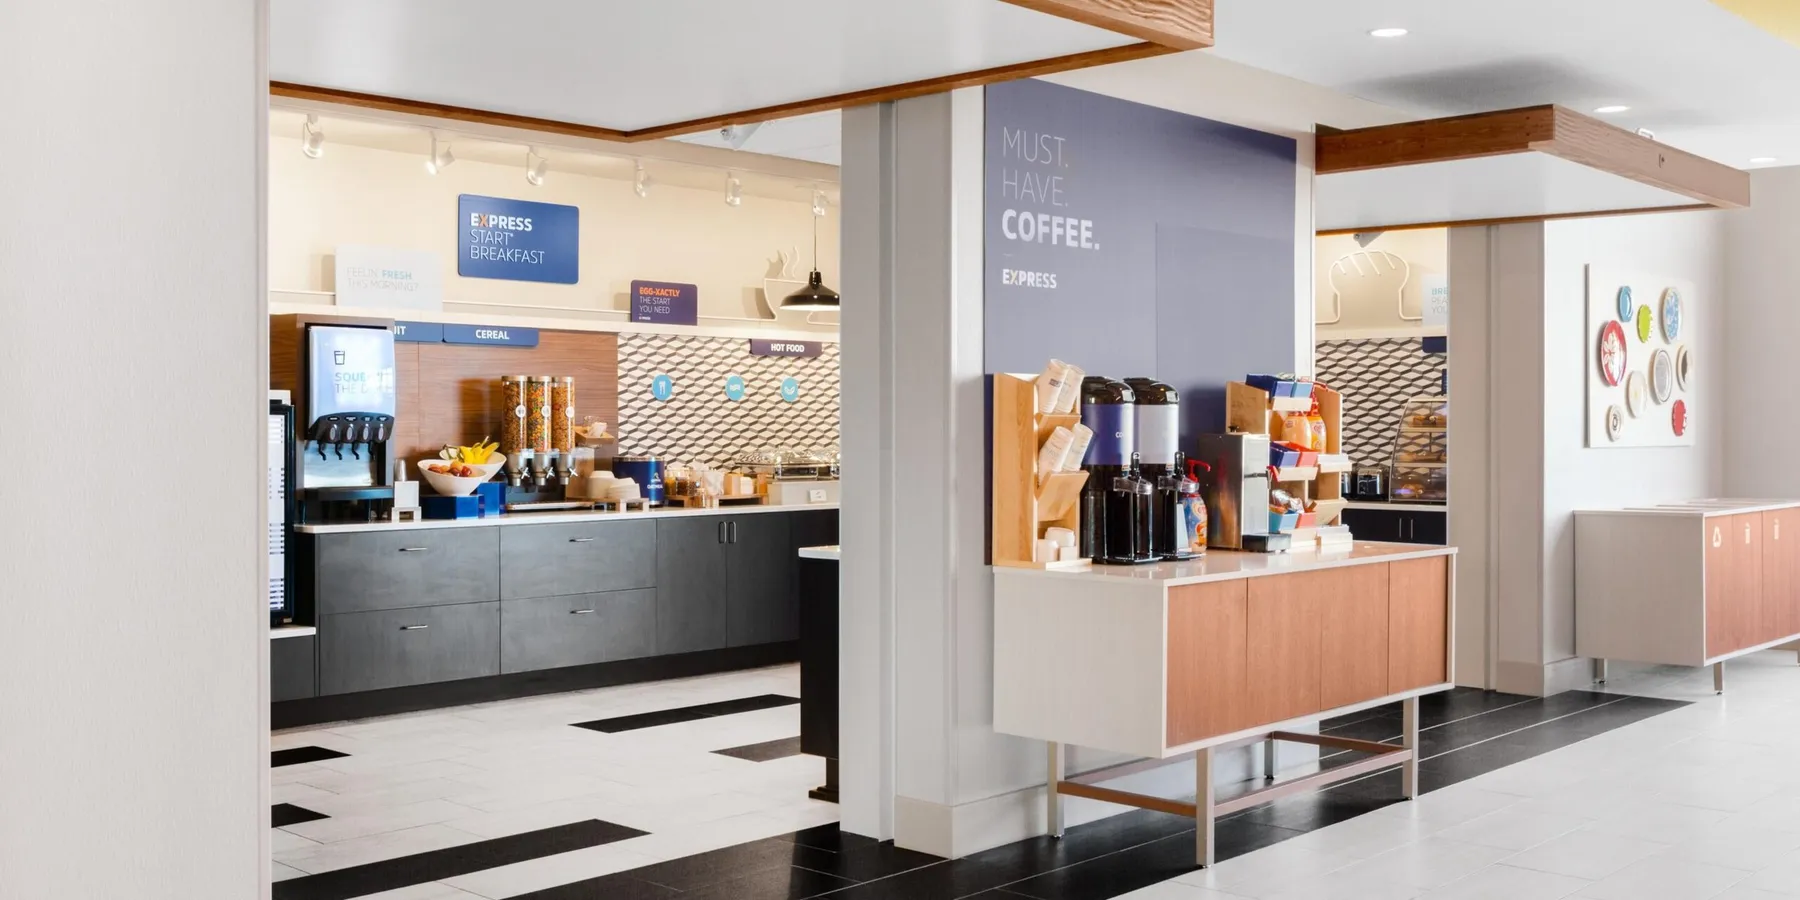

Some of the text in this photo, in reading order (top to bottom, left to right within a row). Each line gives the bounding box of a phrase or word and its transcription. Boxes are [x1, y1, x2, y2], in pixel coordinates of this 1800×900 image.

[1003, 126, 1068, 168] MUST.
[1002, 167, 1068, 207] HAVE.
[470, 212, 533, 232] EXPRESS
[1001, 208, 1100, 250] COFFEE.
[470, 245, 545, 264] BREAKFAST
[382, 269, 412, 280] FRESH
[1002, 268, 1057, 289] EXPRESS
[347, 277, 368, 289] THIS
[639, 286, 680, 297] EGG-XACTLY
[640, 295, 670, 305] THE START
[639, 304, 670, 314] YOU NEED
[475, 329, 510, 340] CEREAL
[770, 343, 805, 353] HOT FOOD
[335, 383, 356, 394] THE
